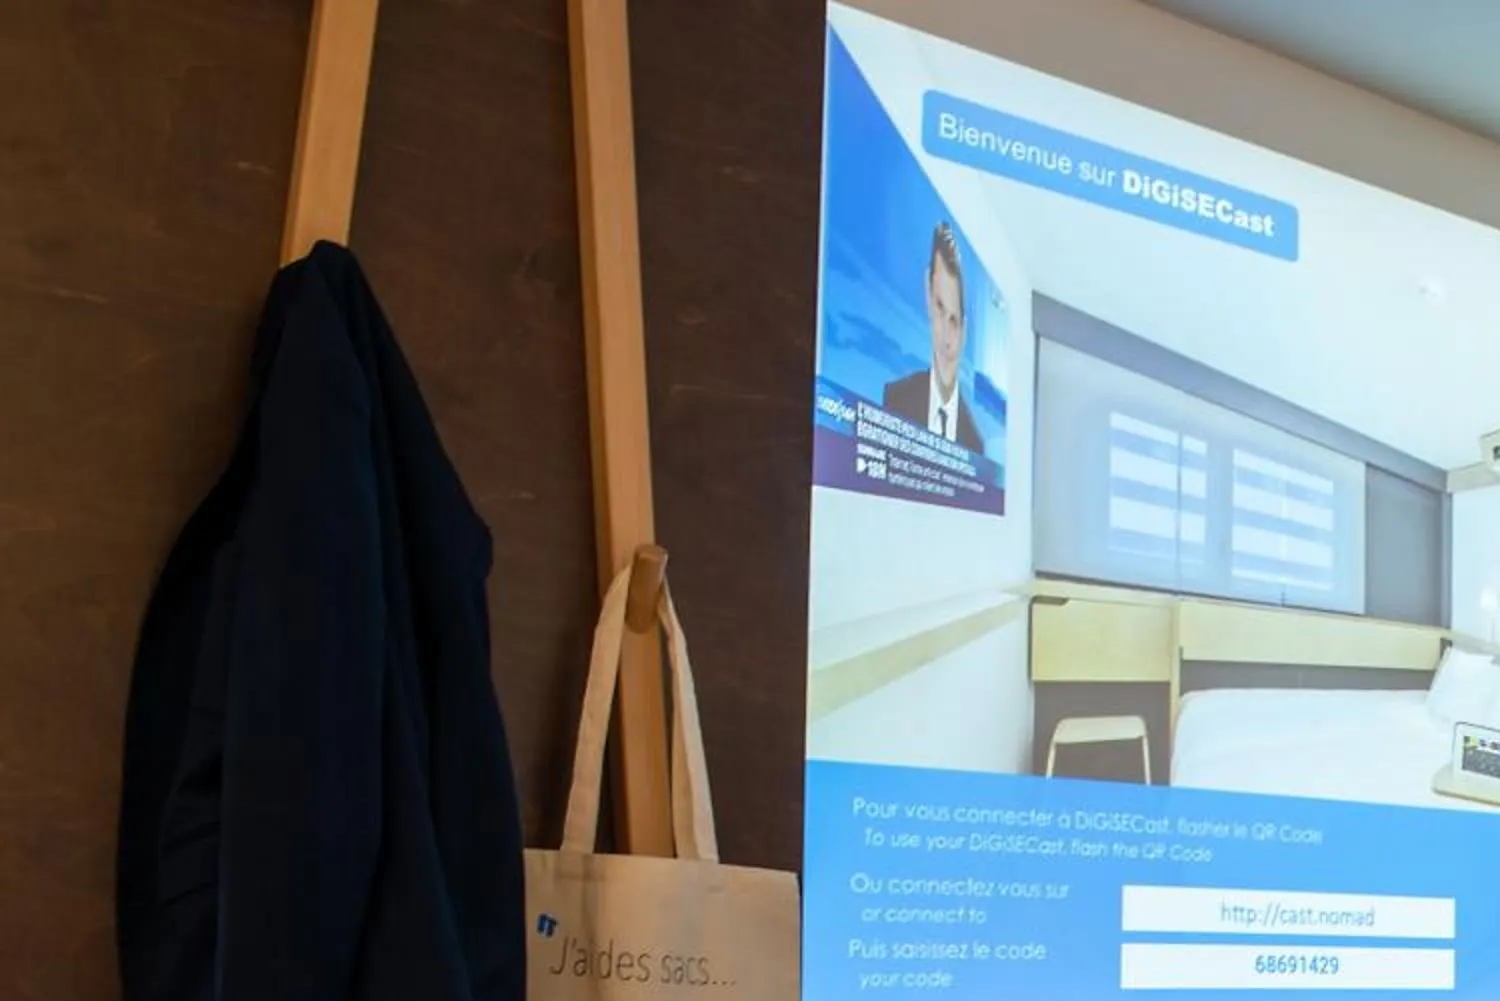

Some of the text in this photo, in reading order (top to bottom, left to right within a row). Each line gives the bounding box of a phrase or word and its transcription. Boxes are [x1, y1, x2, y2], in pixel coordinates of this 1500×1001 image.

[938, 112, 1275, 236] Bienvenue sur DiGiSECast
[853, 797, 898, 819] Pour
[905, 804, 950, 822] vous
[953, 806, 1053, 827] connecter
[1233, 820, 1248, 839] le
[1251, 823, 1277, 841] QR
[864, 827, 885, 846] To
[891, 833, 920, 847] use
[926, 834, 964, 851] your
[1070, 838, 1108, 857] flash
[1112, 843, 1138, 858] the
[1142, 844, 1165, 860] QR
[1169, 845, 1214, 862] Code
[850, 872, 1070, 898] Ou connectez vous sur
[861, 906, 987, 924] or connect to
[1220, 900, 1375, 927] http://cast.nomad
[599, 938, 652, 982] des
[849, 937, 1047, 960] Puis saisissez le code
[1255, 955, 1340, 974] 68691429
[859, 969, 953, 989] your code
